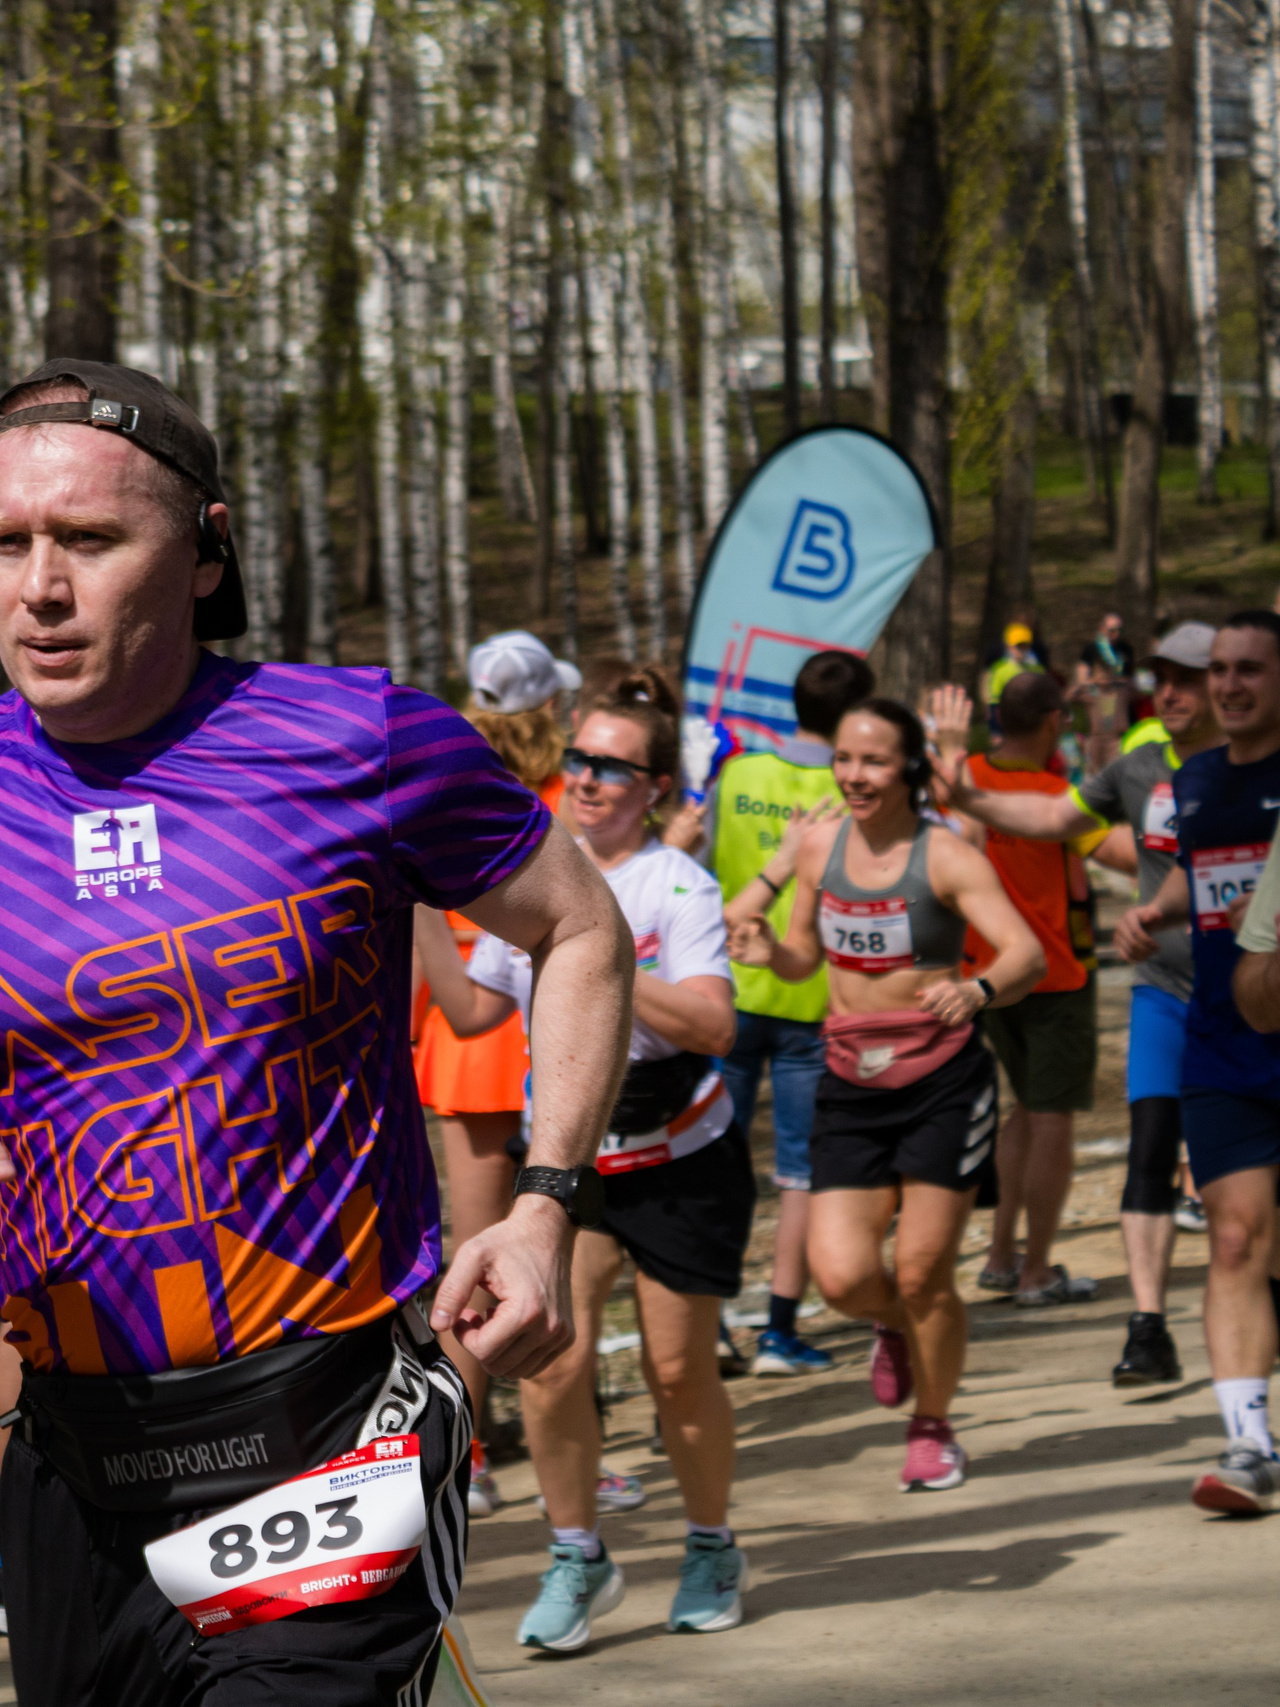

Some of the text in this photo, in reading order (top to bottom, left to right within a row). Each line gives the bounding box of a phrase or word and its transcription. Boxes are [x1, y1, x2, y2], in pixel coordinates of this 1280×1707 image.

[75, 864, 162, 887] EUROPE
[76, 878, 164, 901] ASIA
[833, 926, 887, 954] 768
[103, 1433, 269, 1486] MOVED FOR LIGHT
[329, 1462, 412, 1485] ВИКТОРИЯ
[208, 1494, 364, 1579] 893
